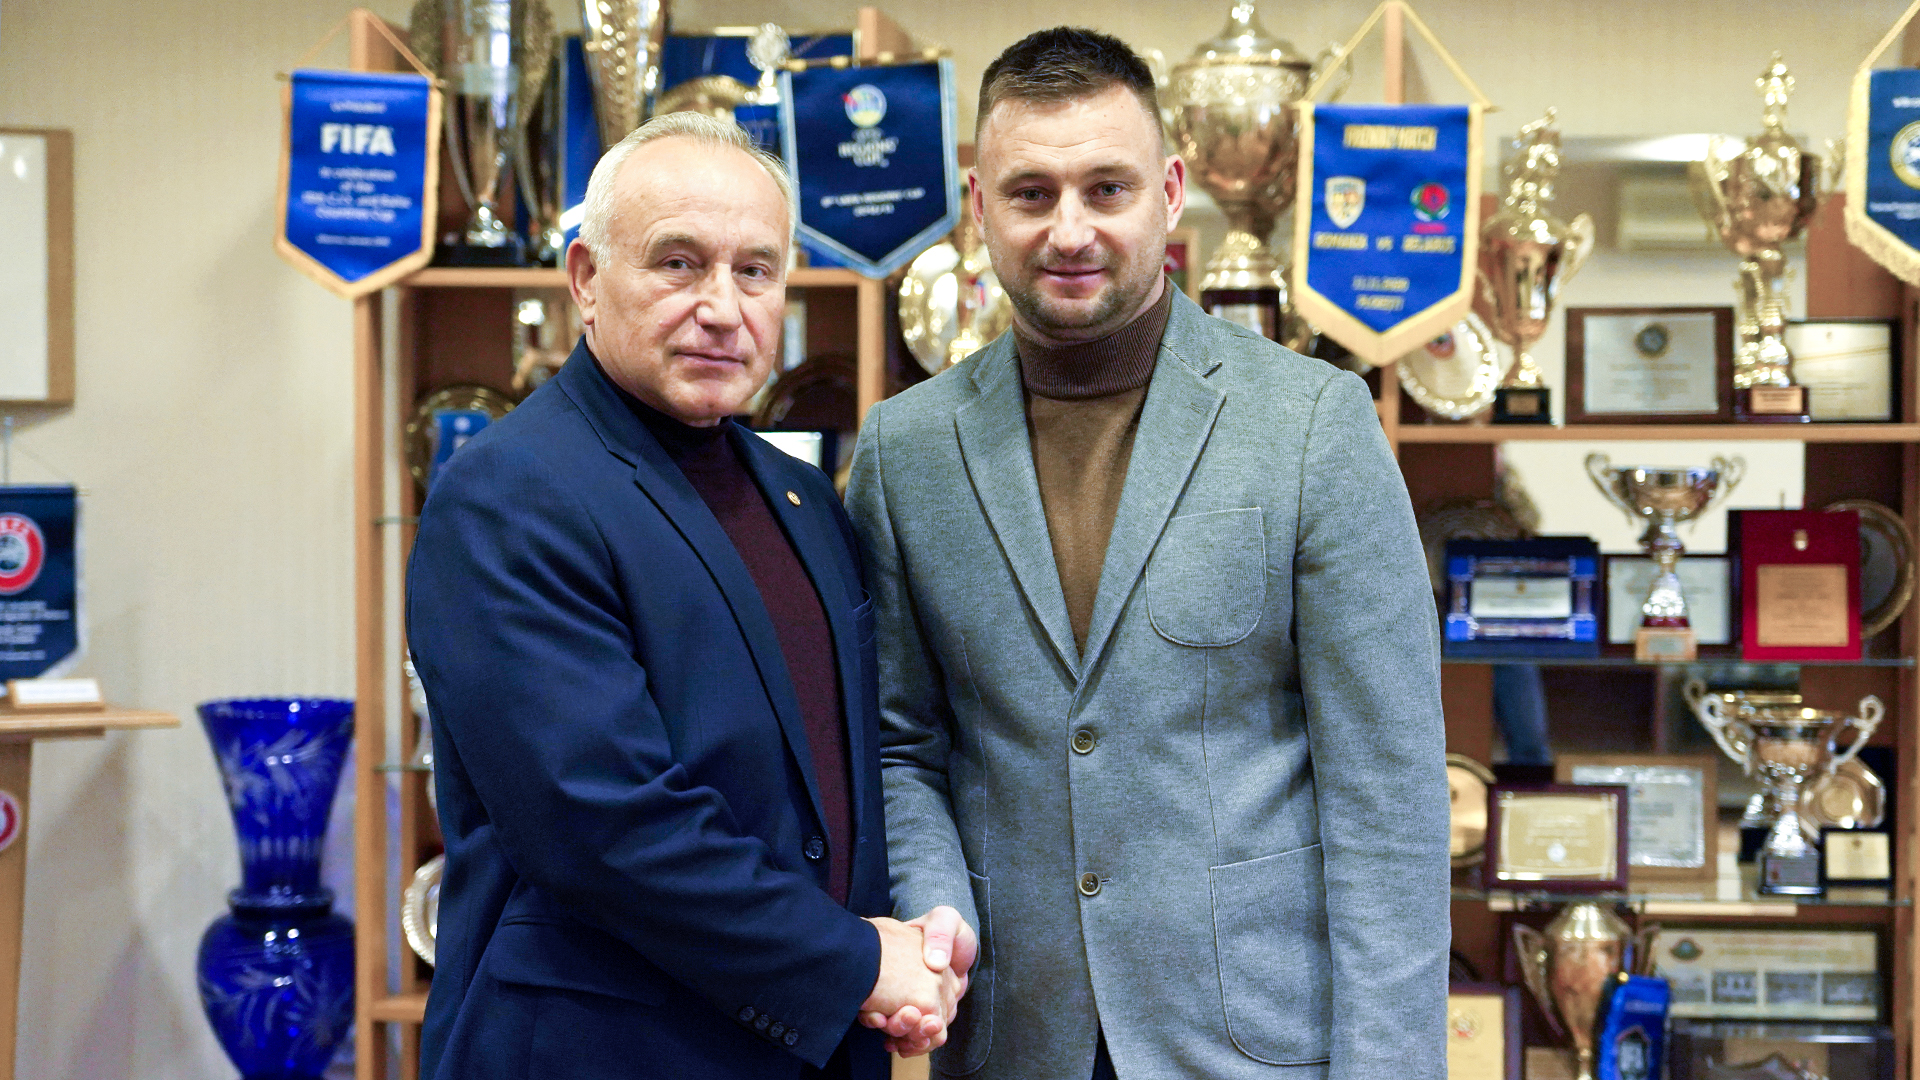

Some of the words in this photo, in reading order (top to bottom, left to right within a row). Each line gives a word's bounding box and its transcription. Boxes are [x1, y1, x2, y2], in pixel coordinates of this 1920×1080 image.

[321, 123, 396, 156] FIFA
[1344, 125, 1395, 149] FRIENDLY
[1398, 126, 1438, 150] MATCH
[334, 167, 397, 181] celebration
[340, 180, 352, 192] of
[355, 181, 374, 193] the
[371, 208, 396, 222] Cup
[1314, 232, 1368, 250] ROMANIA
[1402, 235, 1456, 254] BELARUS
